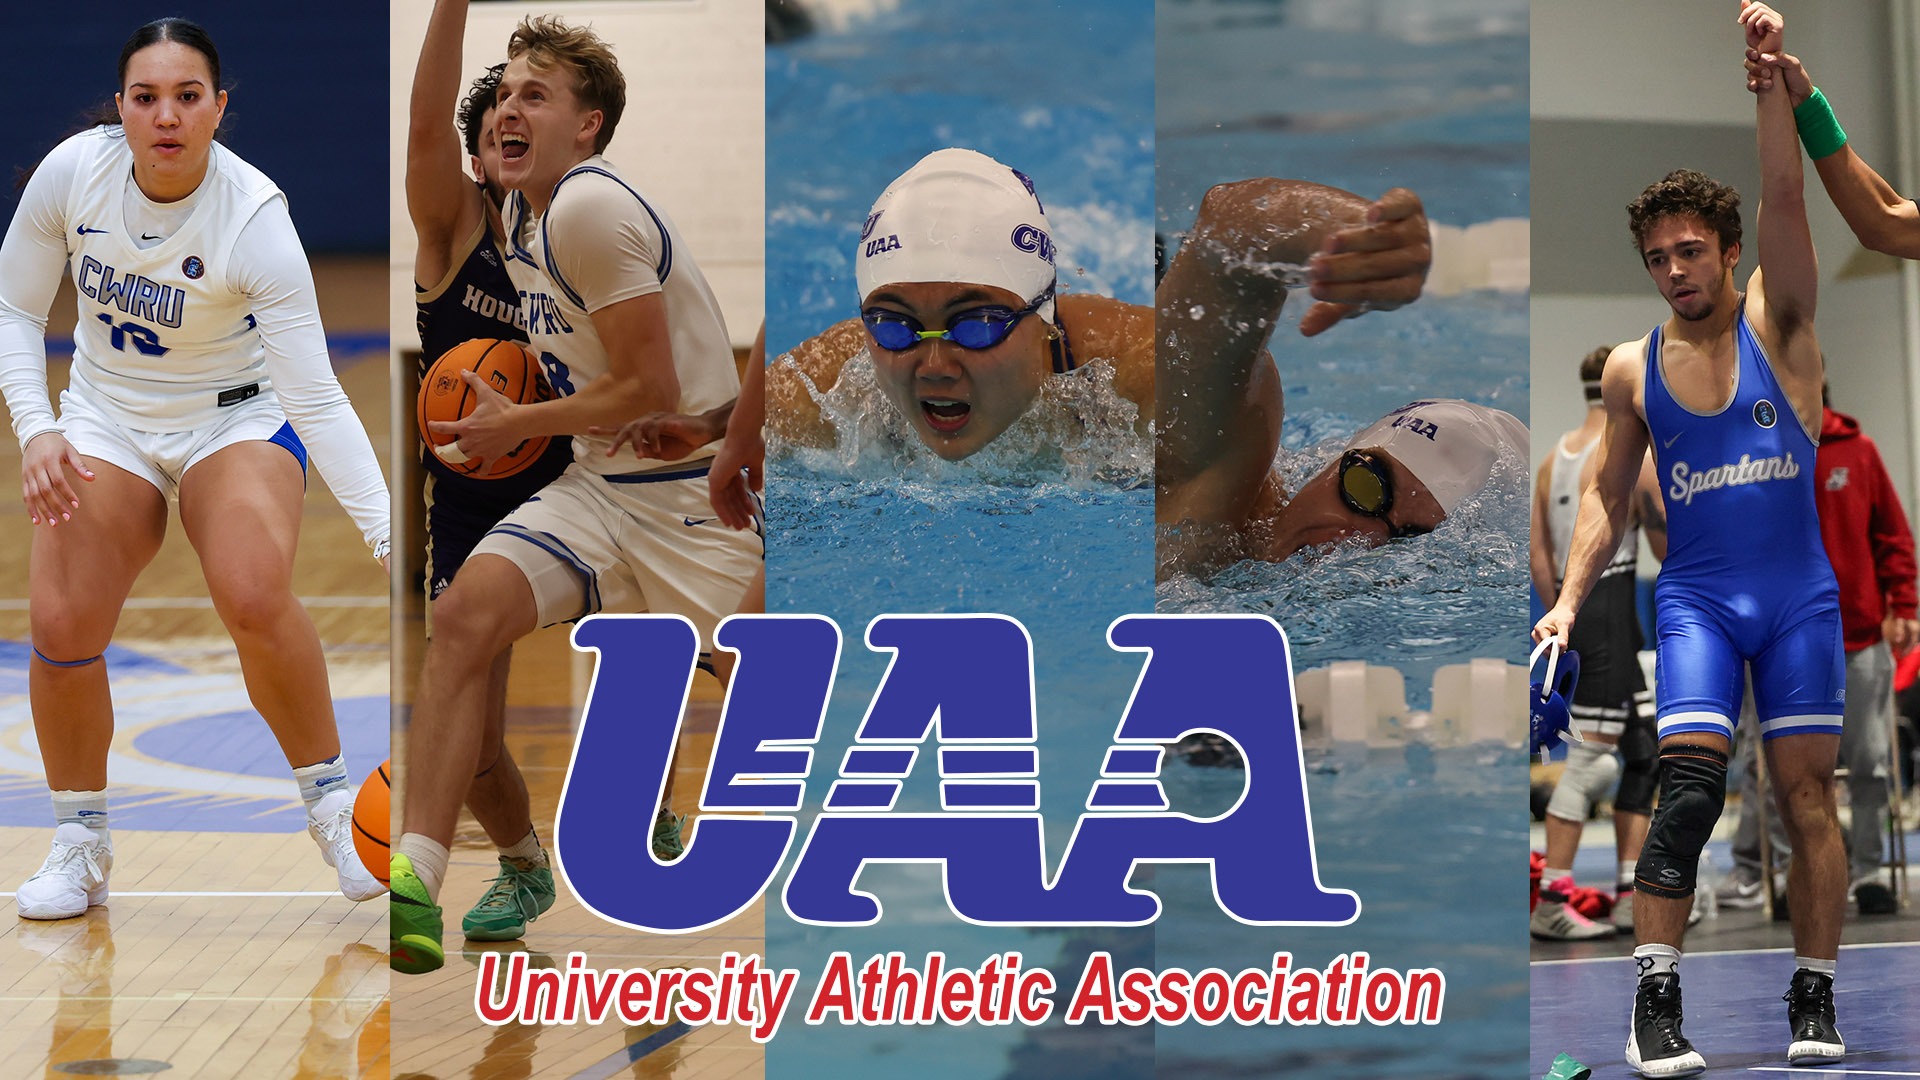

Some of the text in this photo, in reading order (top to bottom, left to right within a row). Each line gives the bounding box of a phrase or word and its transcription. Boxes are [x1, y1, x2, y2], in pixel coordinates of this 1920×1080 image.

[865, 234, 902, 258] UAA
[78, 254, 186, 329] CWRU
[1391, 415, 1439, 442] UAA
[1669, 451, 1800, 506] Spartans
